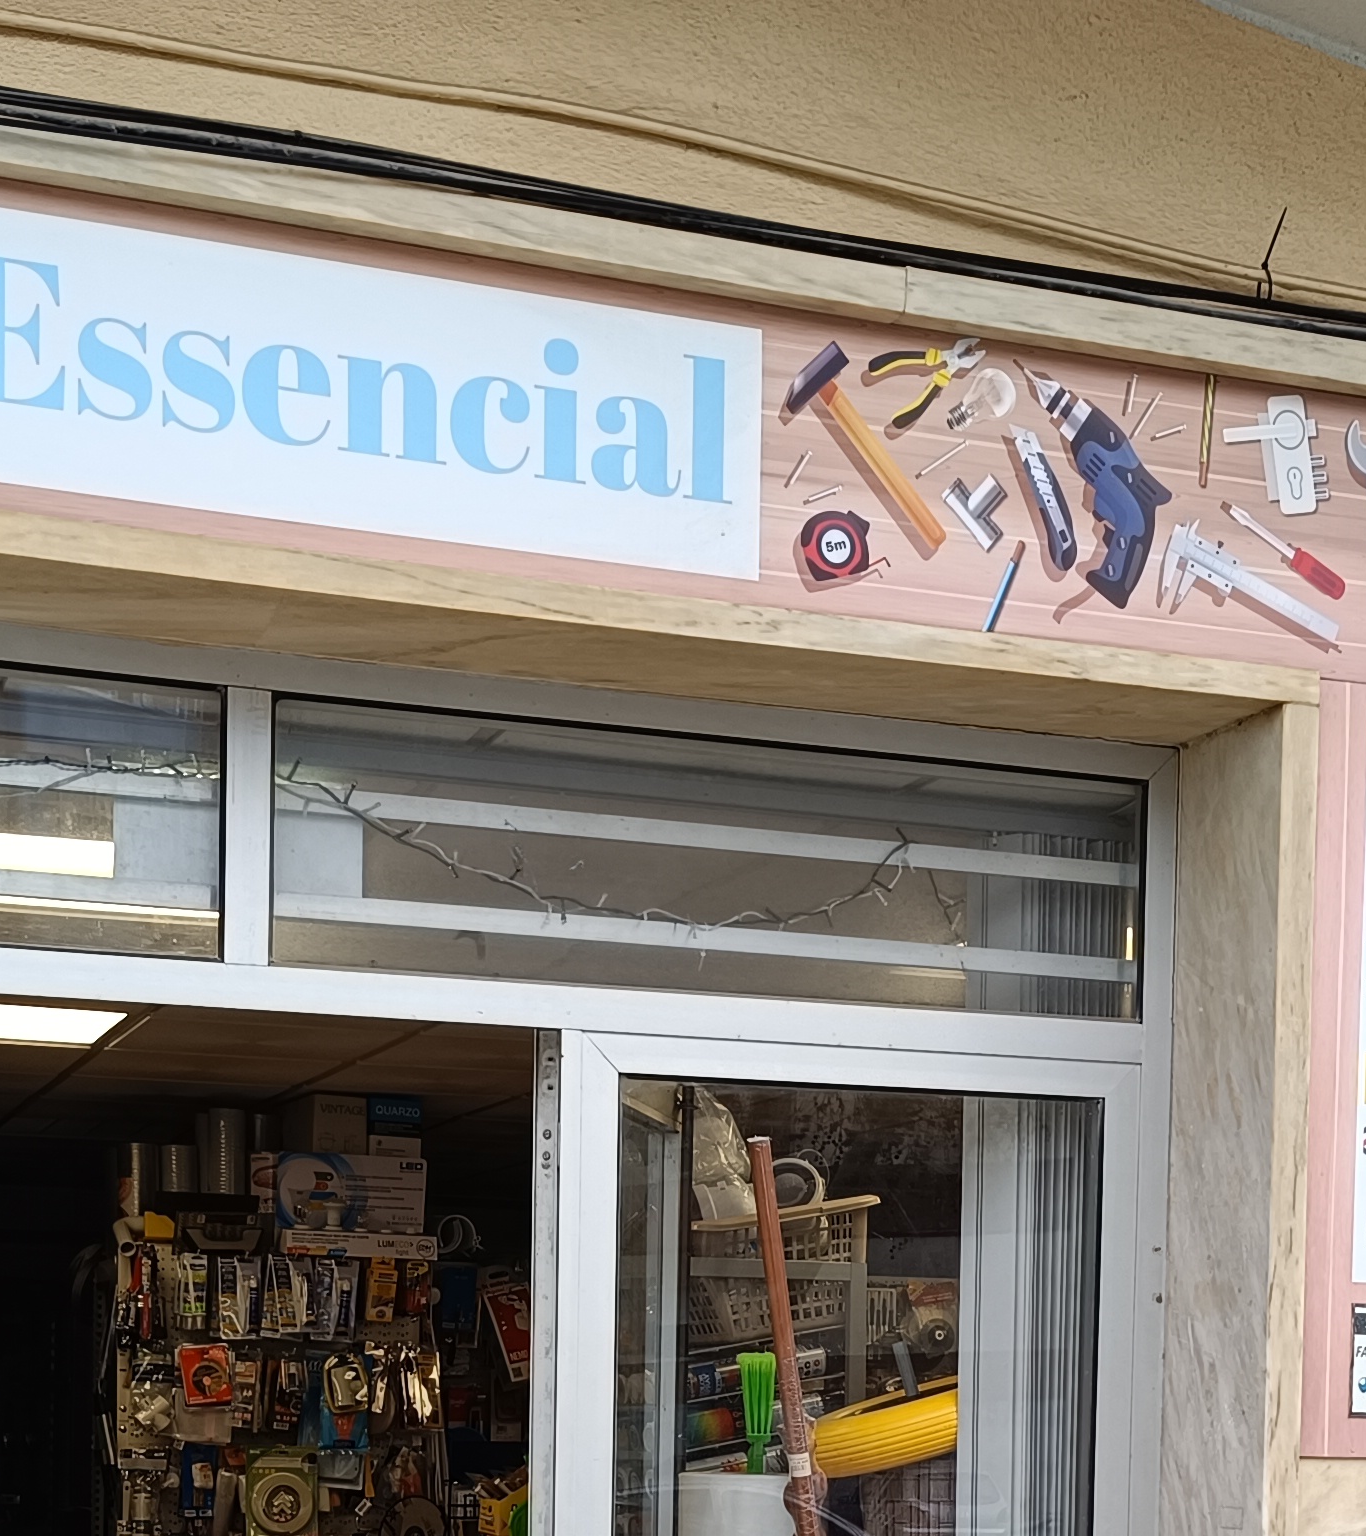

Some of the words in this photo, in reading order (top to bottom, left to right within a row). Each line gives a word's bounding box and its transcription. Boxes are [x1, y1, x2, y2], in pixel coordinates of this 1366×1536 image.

[825, 540, 847, 553] 5m
[320, 1103, 366, 1117] VINTAGE
[375, 1104, 421, 1118] QUARZO
[399, 1161, 424, 1171] LED
